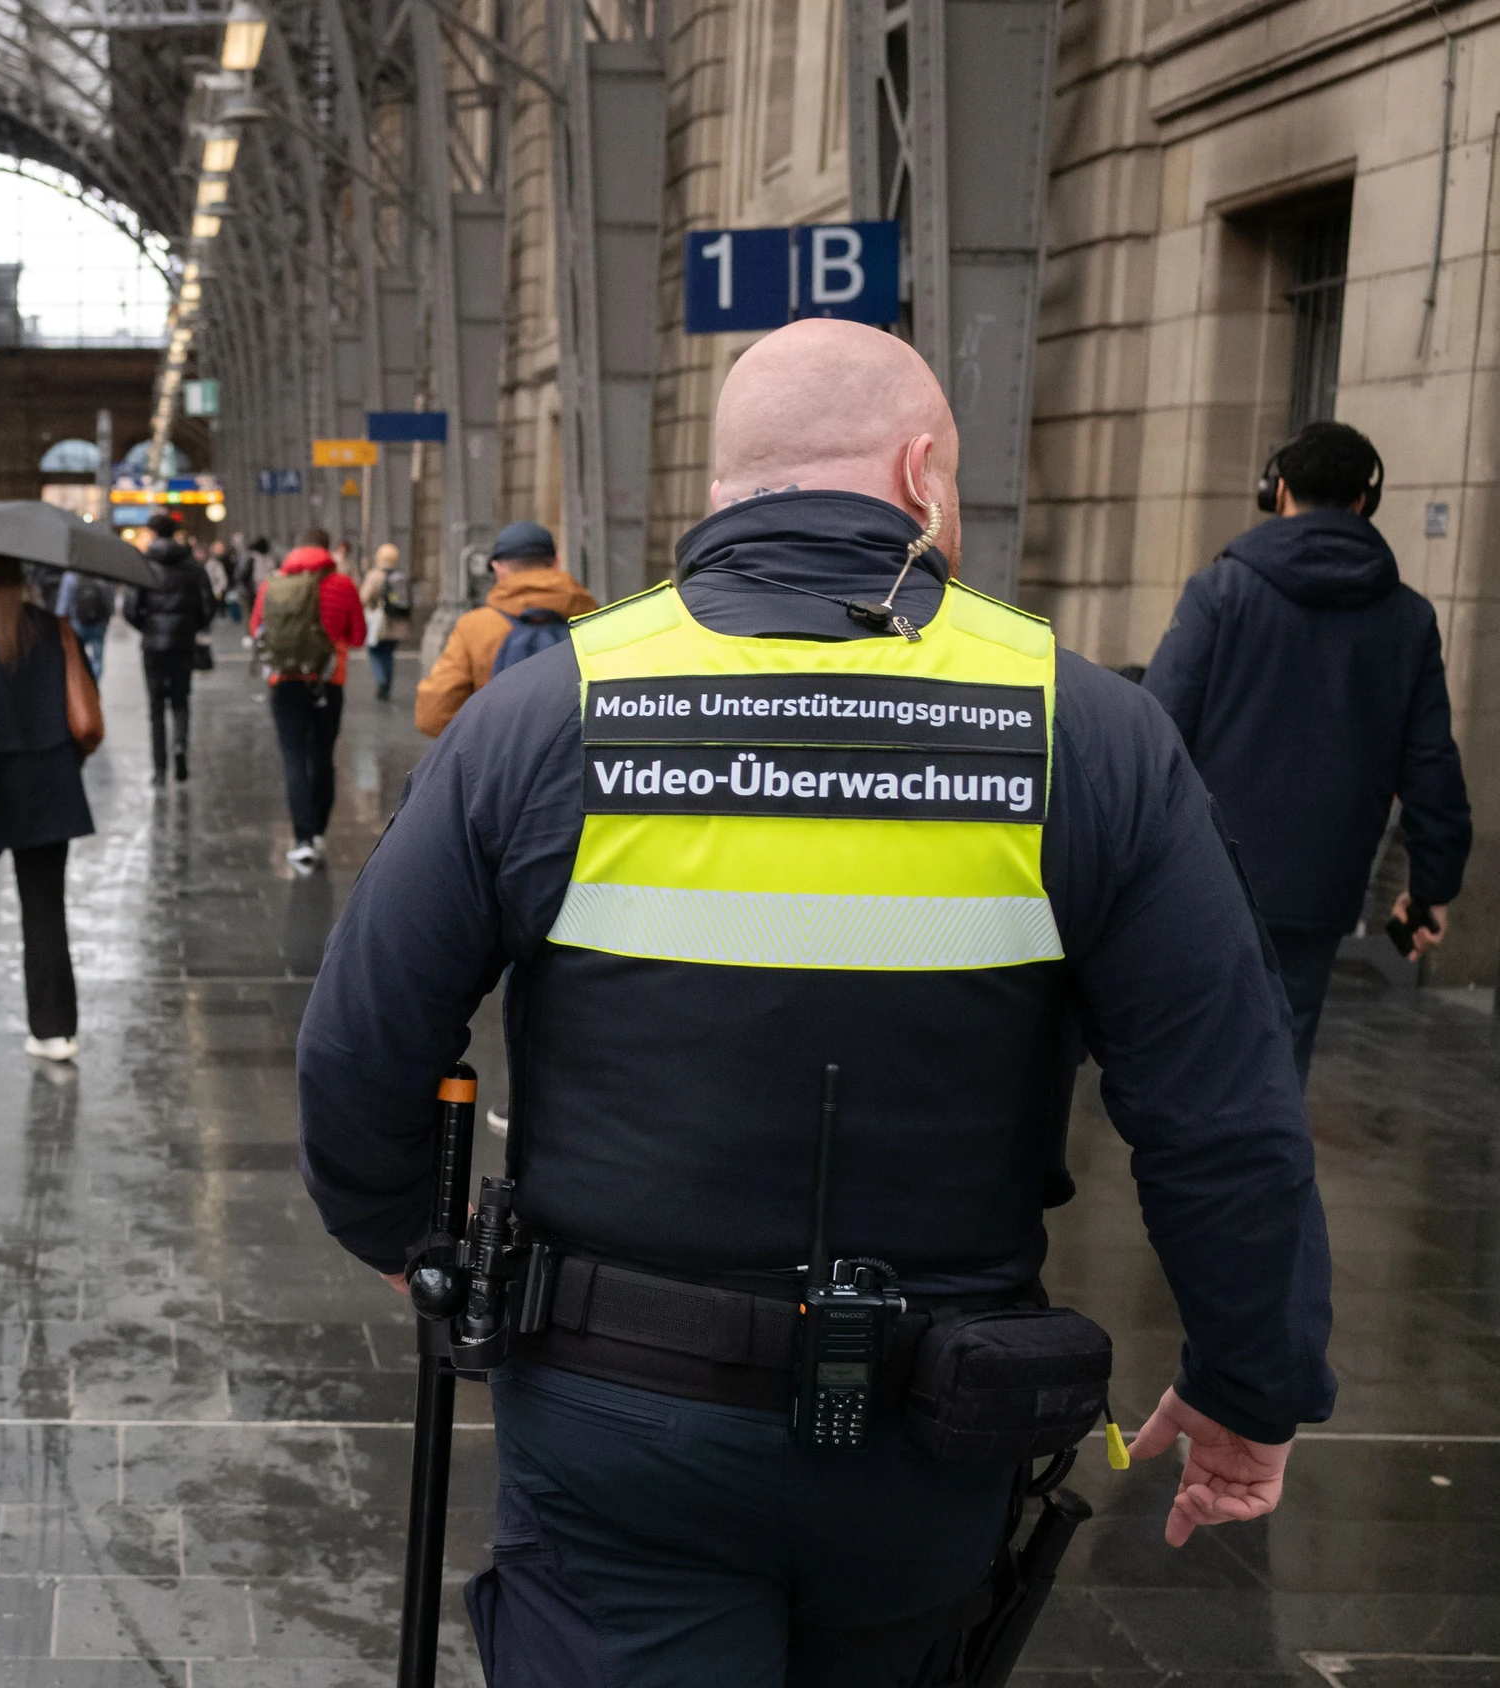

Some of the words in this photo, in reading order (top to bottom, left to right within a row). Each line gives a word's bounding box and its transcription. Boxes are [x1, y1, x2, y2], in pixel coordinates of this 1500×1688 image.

[702, 233, 732, 309] 1
[812, 227, 865, 303] B
[595, 693, 691, 717] Mobile
[700, 693, 1032, 731] Unterstützungsgruppe
[594, 753, 1033, 812] Video-Überwachung
